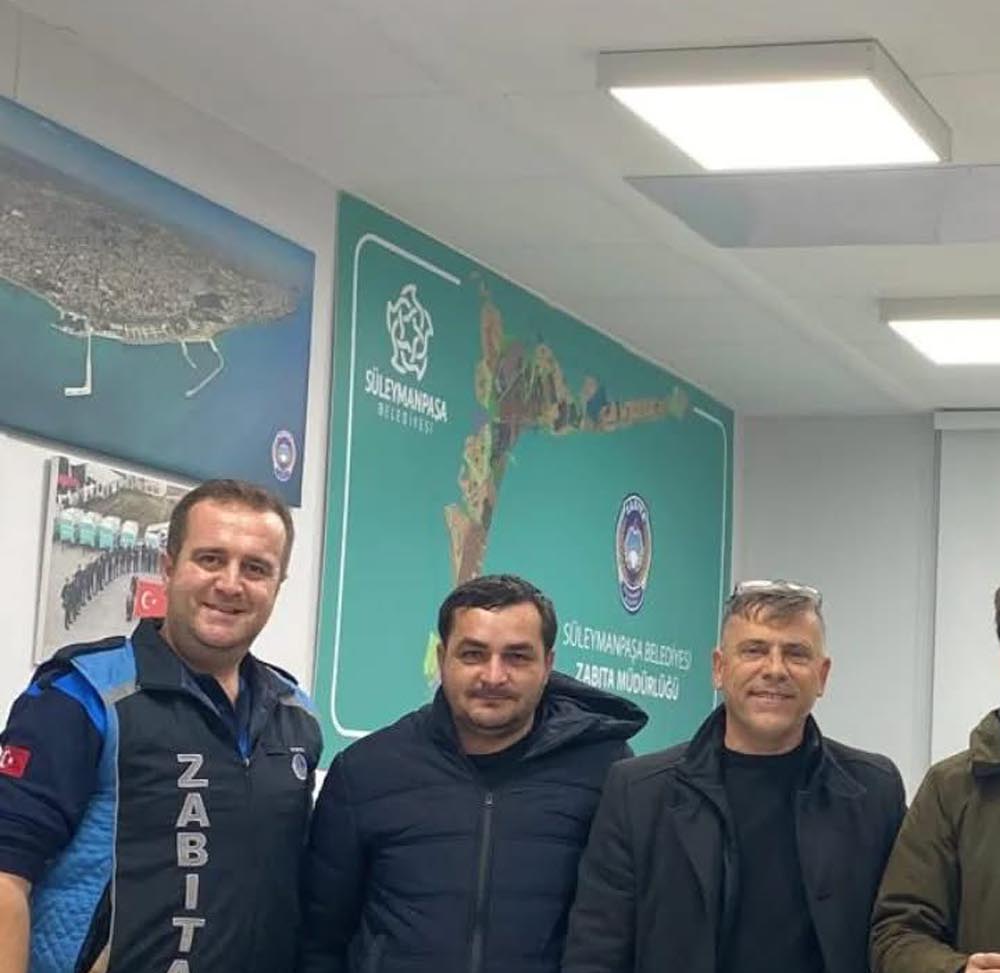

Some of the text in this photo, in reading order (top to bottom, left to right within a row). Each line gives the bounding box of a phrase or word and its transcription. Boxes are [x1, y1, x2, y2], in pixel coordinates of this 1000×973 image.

[365, 367, 448, 422] SÜLEYMANPAŞA
[562, 620, 643, 663] SÜLEYMANPAŞA
[575, 662, 680, 701] ZABITA MÜDÜRLÜĞÜ
